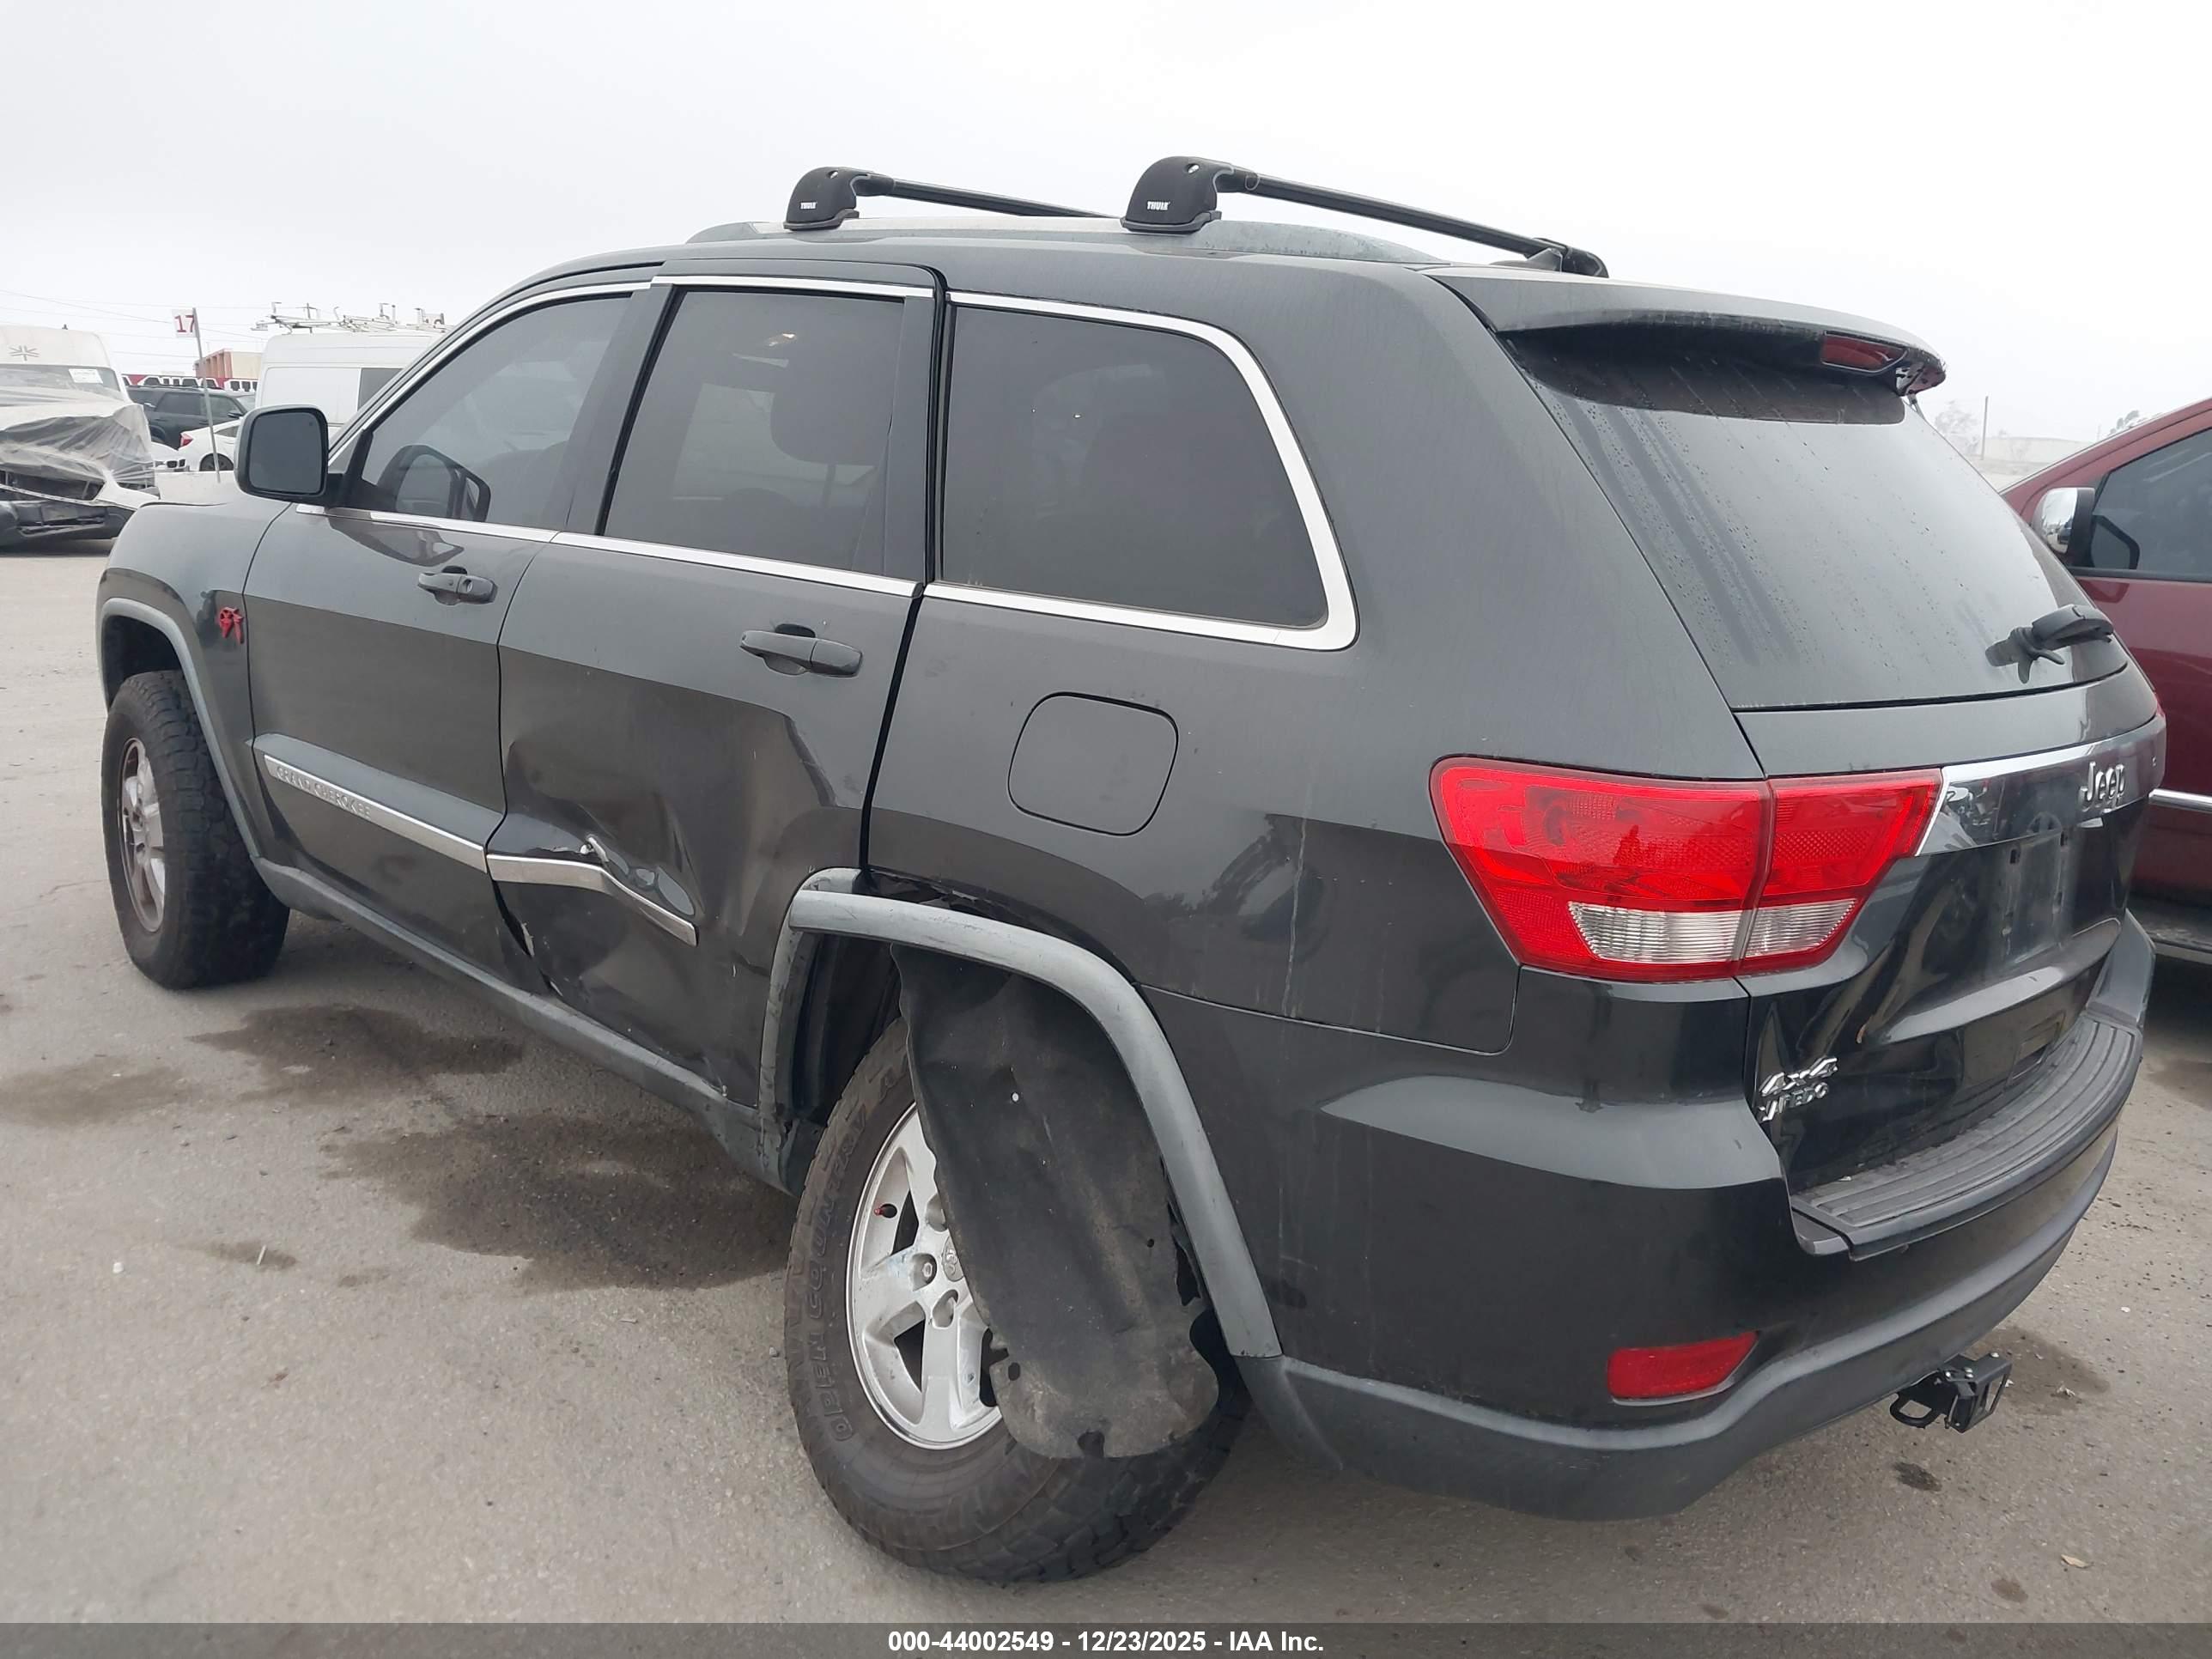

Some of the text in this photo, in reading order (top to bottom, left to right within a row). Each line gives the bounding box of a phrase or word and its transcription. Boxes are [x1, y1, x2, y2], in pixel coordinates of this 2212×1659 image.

[1146, 200, 1170, 211] THULE
[174, 314, 194, 332] 17
[2078, 761, 2124, 809] Jeep
[808, 1331, 854, 1442] OPEN
